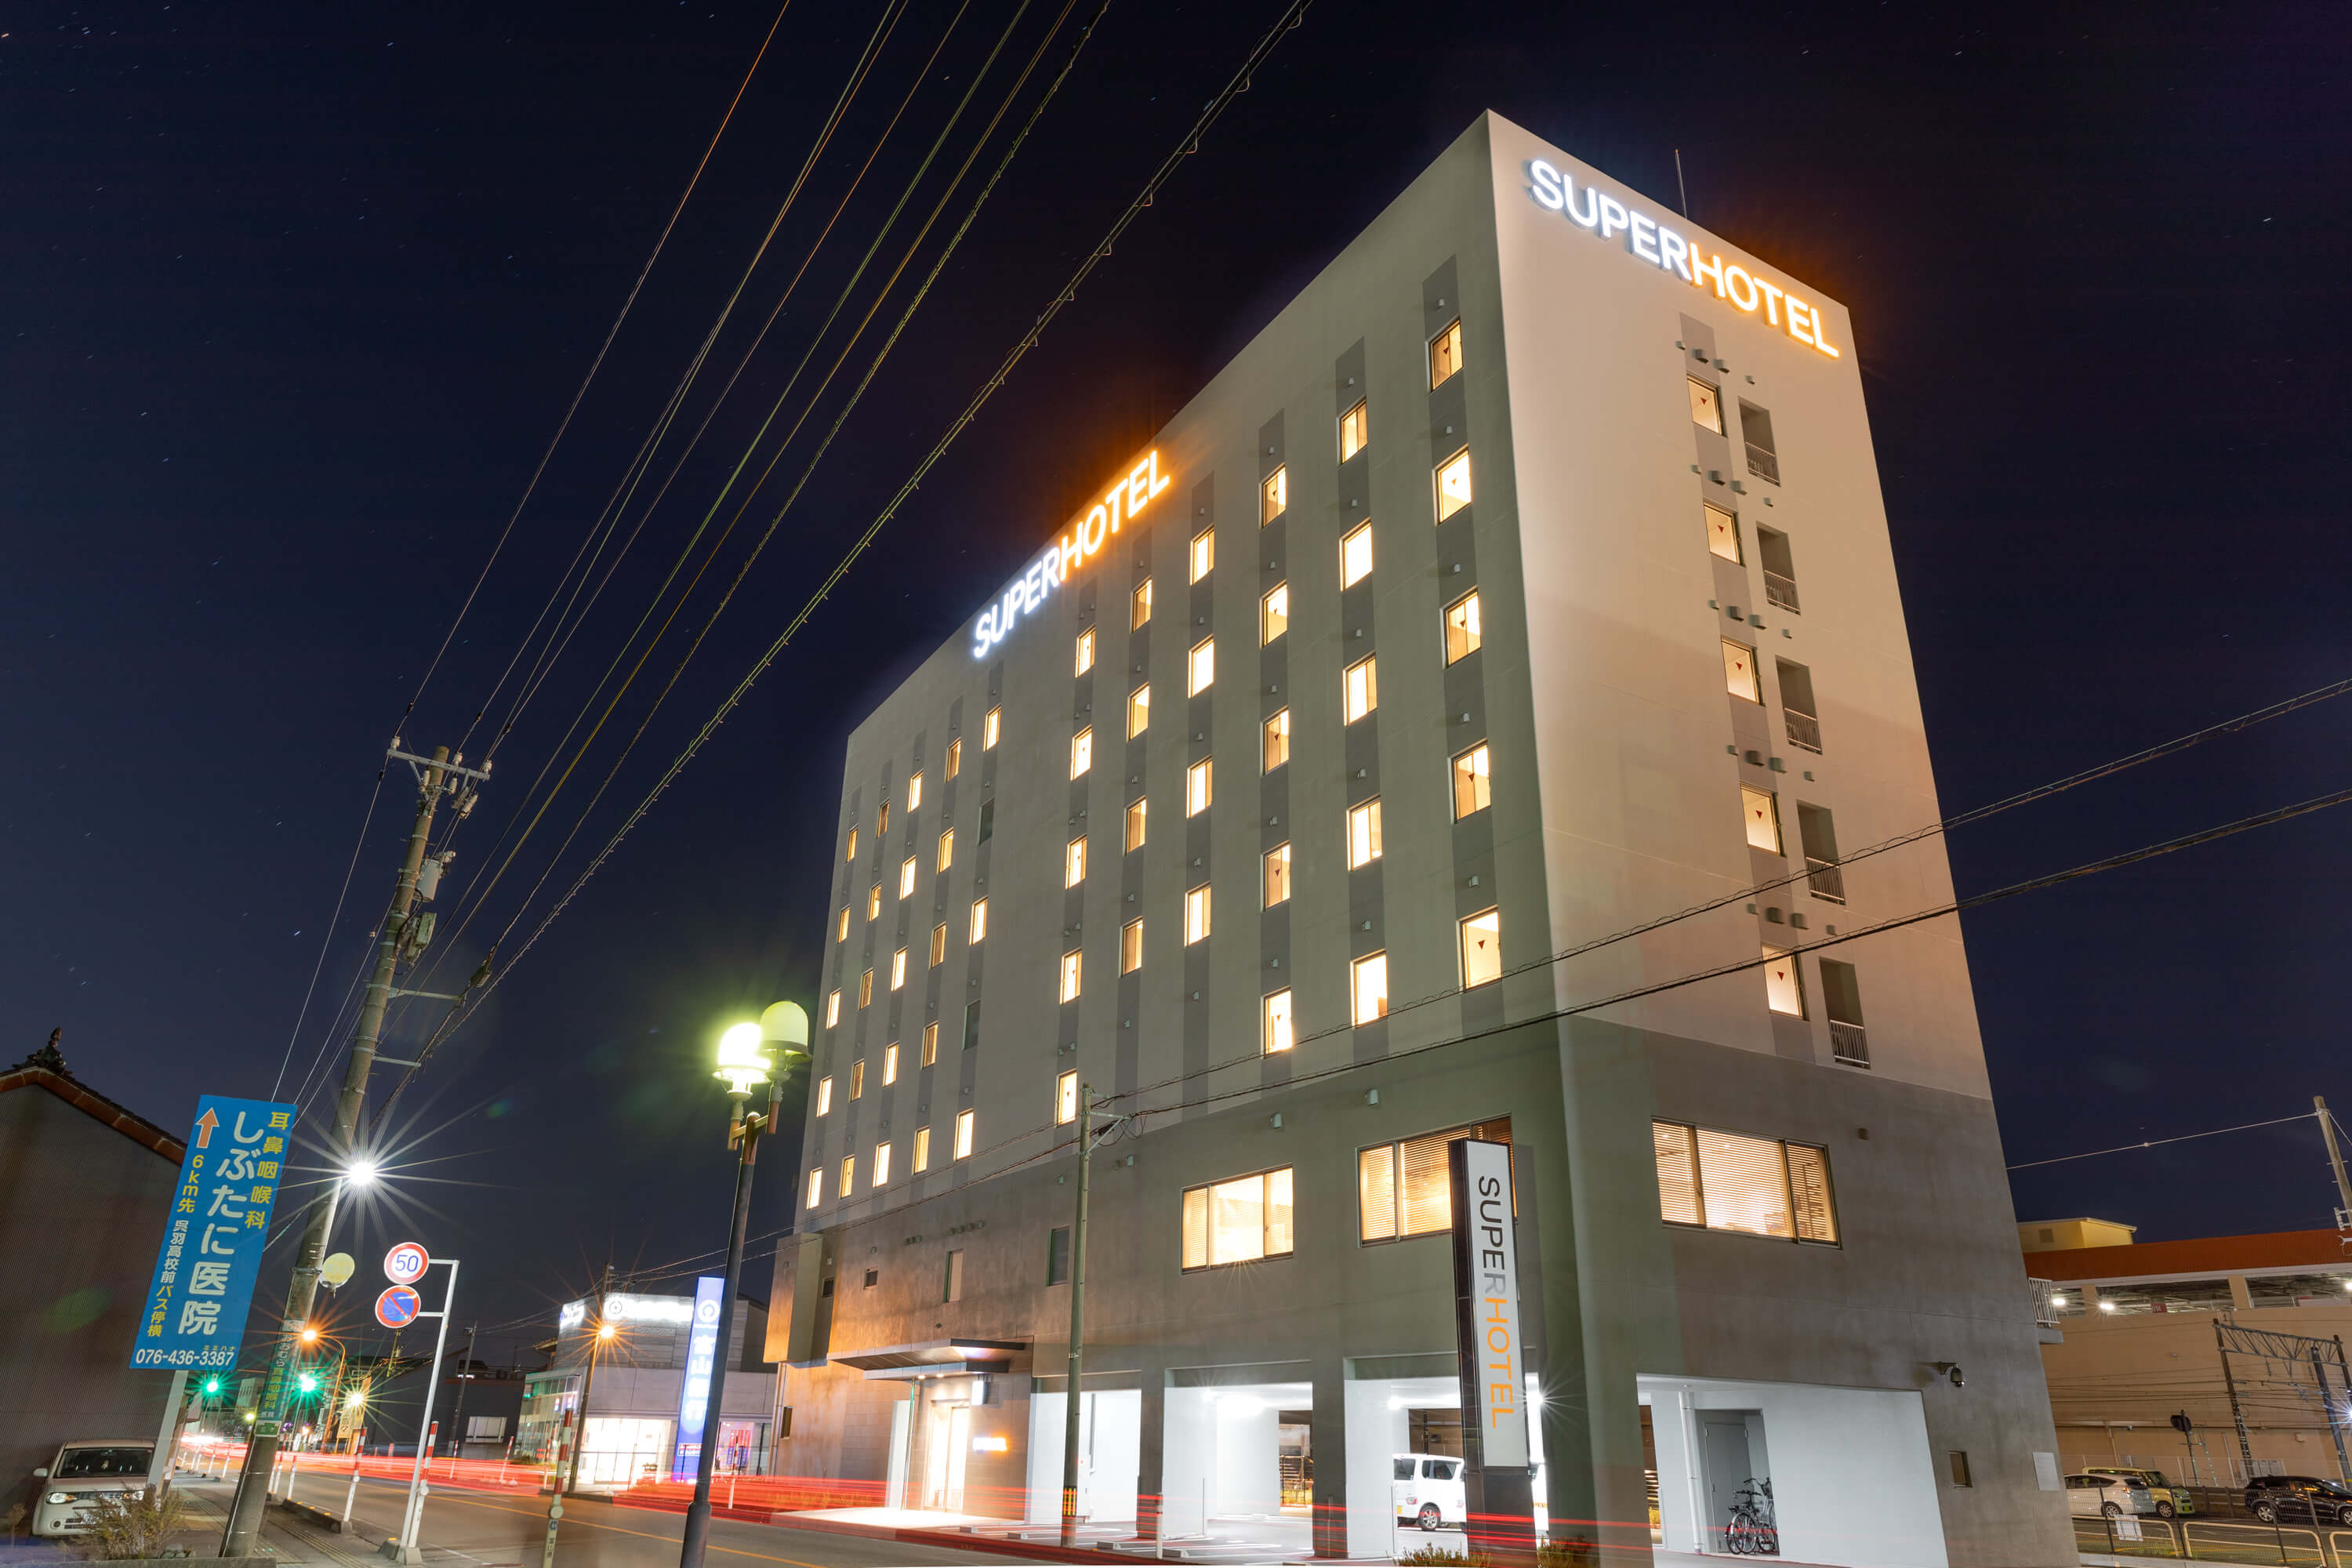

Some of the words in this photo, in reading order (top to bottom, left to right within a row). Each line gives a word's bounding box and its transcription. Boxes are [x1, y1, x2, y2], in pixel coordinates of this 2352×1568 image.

[177, 1110, 264, 1336] しぶたに医院
[245, 1110, 290, 1230] 耳鼻咽喉科
[394, 1254, 419, 1272] 50
[1479, 1175, 1515, 1429] SUPERHOTEL
[135, 1348, 235, 1366] 076-436-3387
